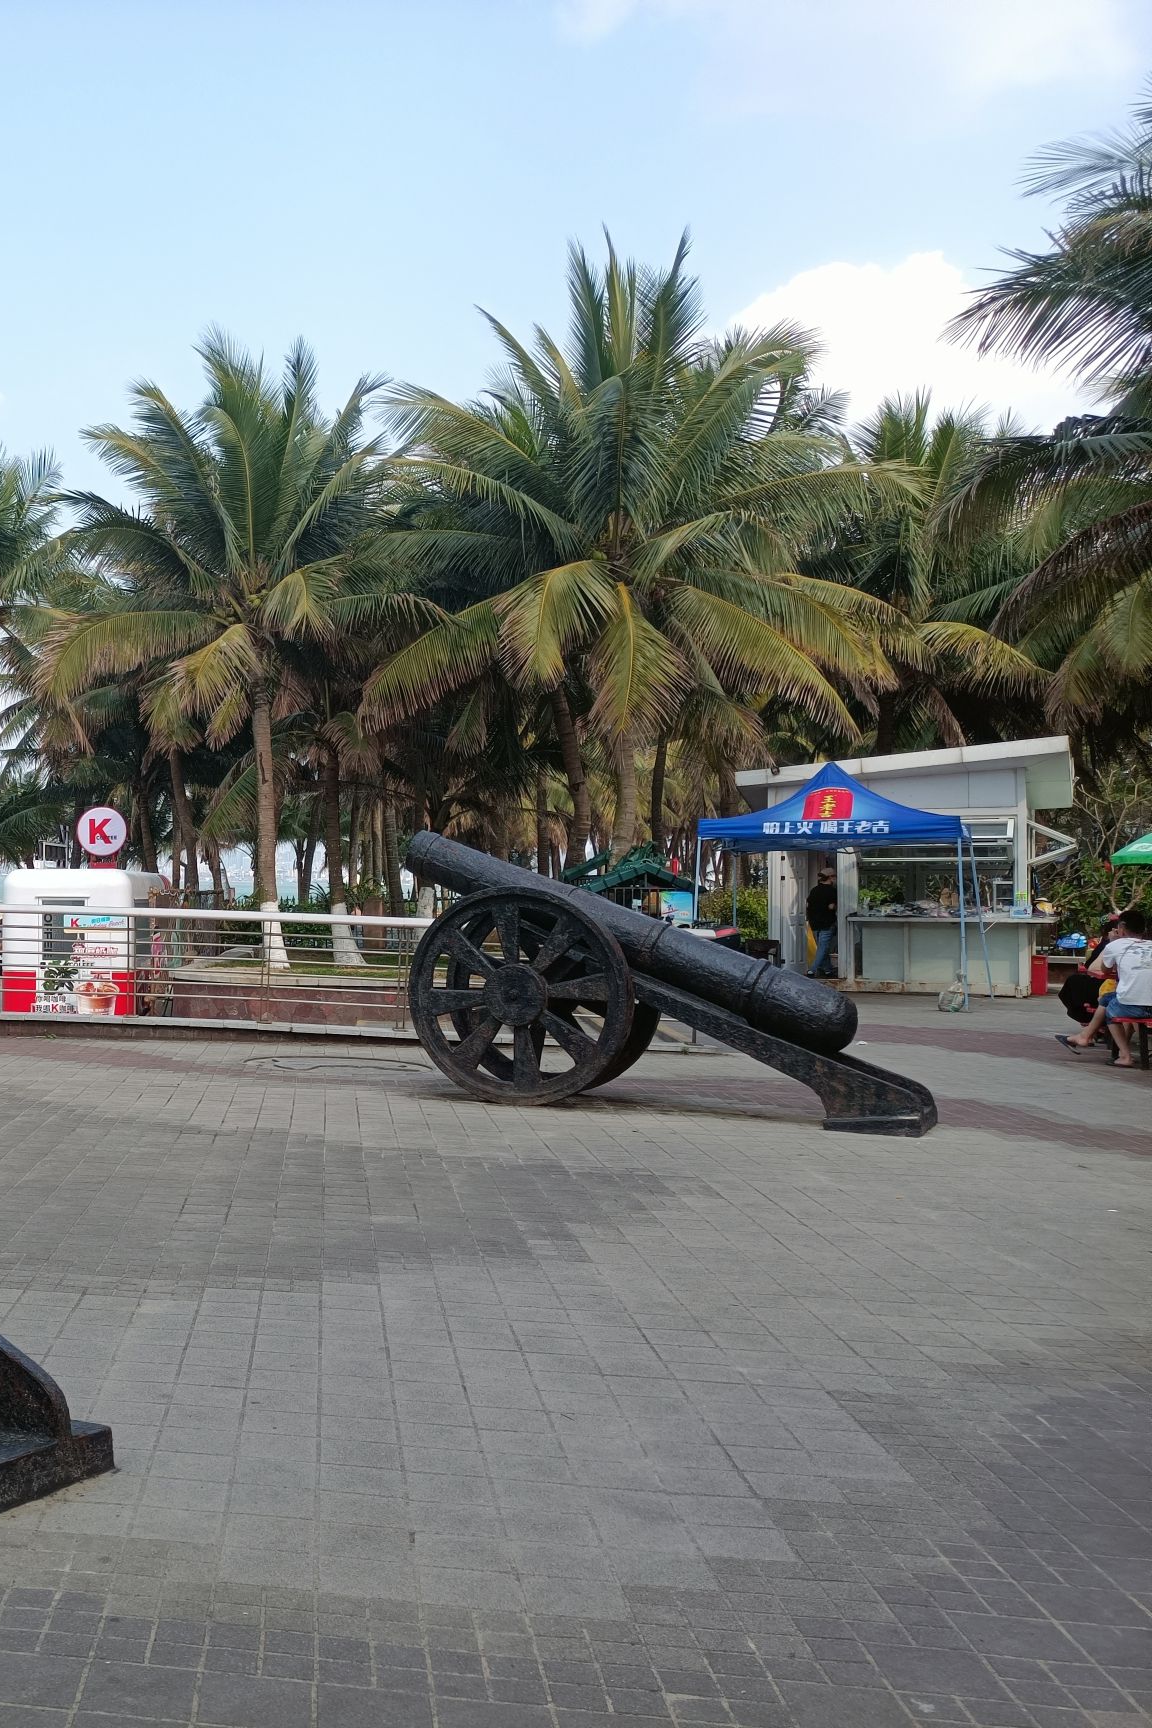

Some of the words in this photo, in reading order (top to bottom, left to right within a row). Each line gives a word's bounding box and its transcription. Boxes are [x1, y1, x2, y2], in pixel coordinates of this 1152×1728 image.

[818, 795, 837, 818] 王老吉
[89, 818, 112, 844] K
[762, 821, 814, 835] 怕上火
[819, 820, 890, 834] 喝王老吉
